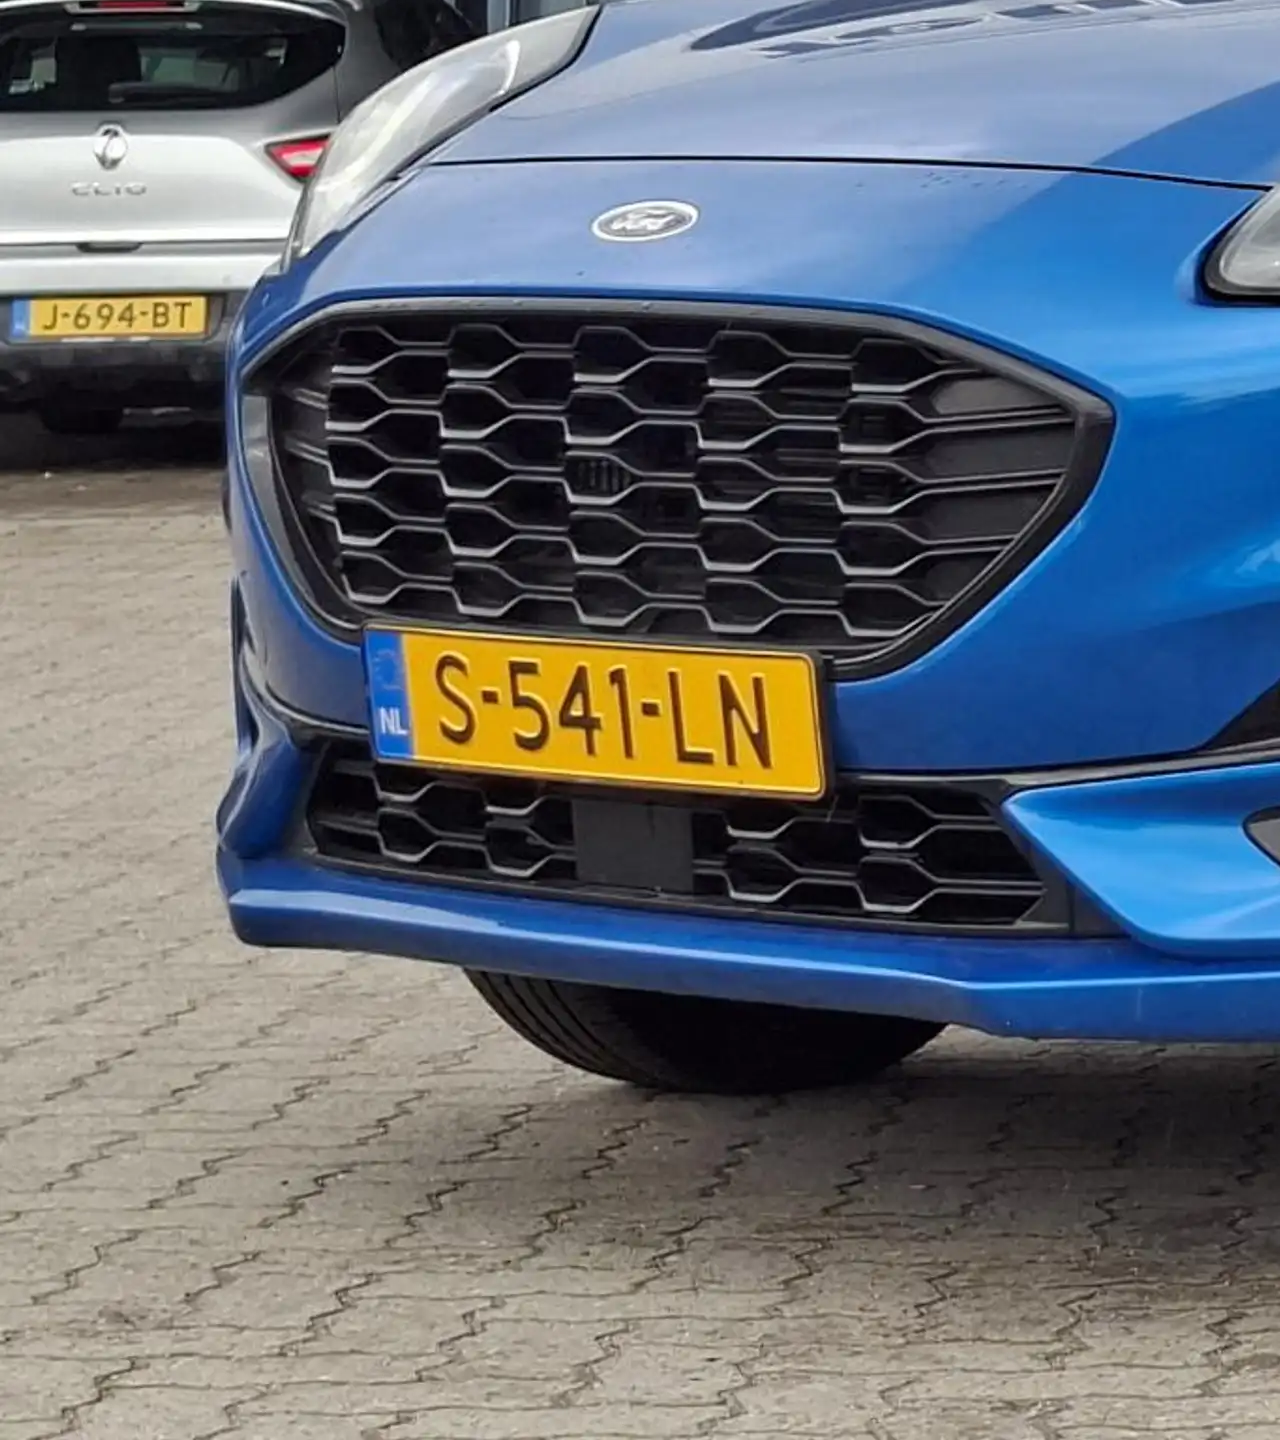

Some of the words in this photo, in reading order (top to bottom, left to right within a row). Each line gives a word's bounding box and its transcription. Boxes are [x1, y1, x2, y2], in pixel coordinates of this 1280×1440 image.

[71, 182, 148, 197] CLIO
[42, 301, 193, 331] J-694-BT
[380, 706, 409, 735] NL
[435, 653, 773, 768] S-541-LN
